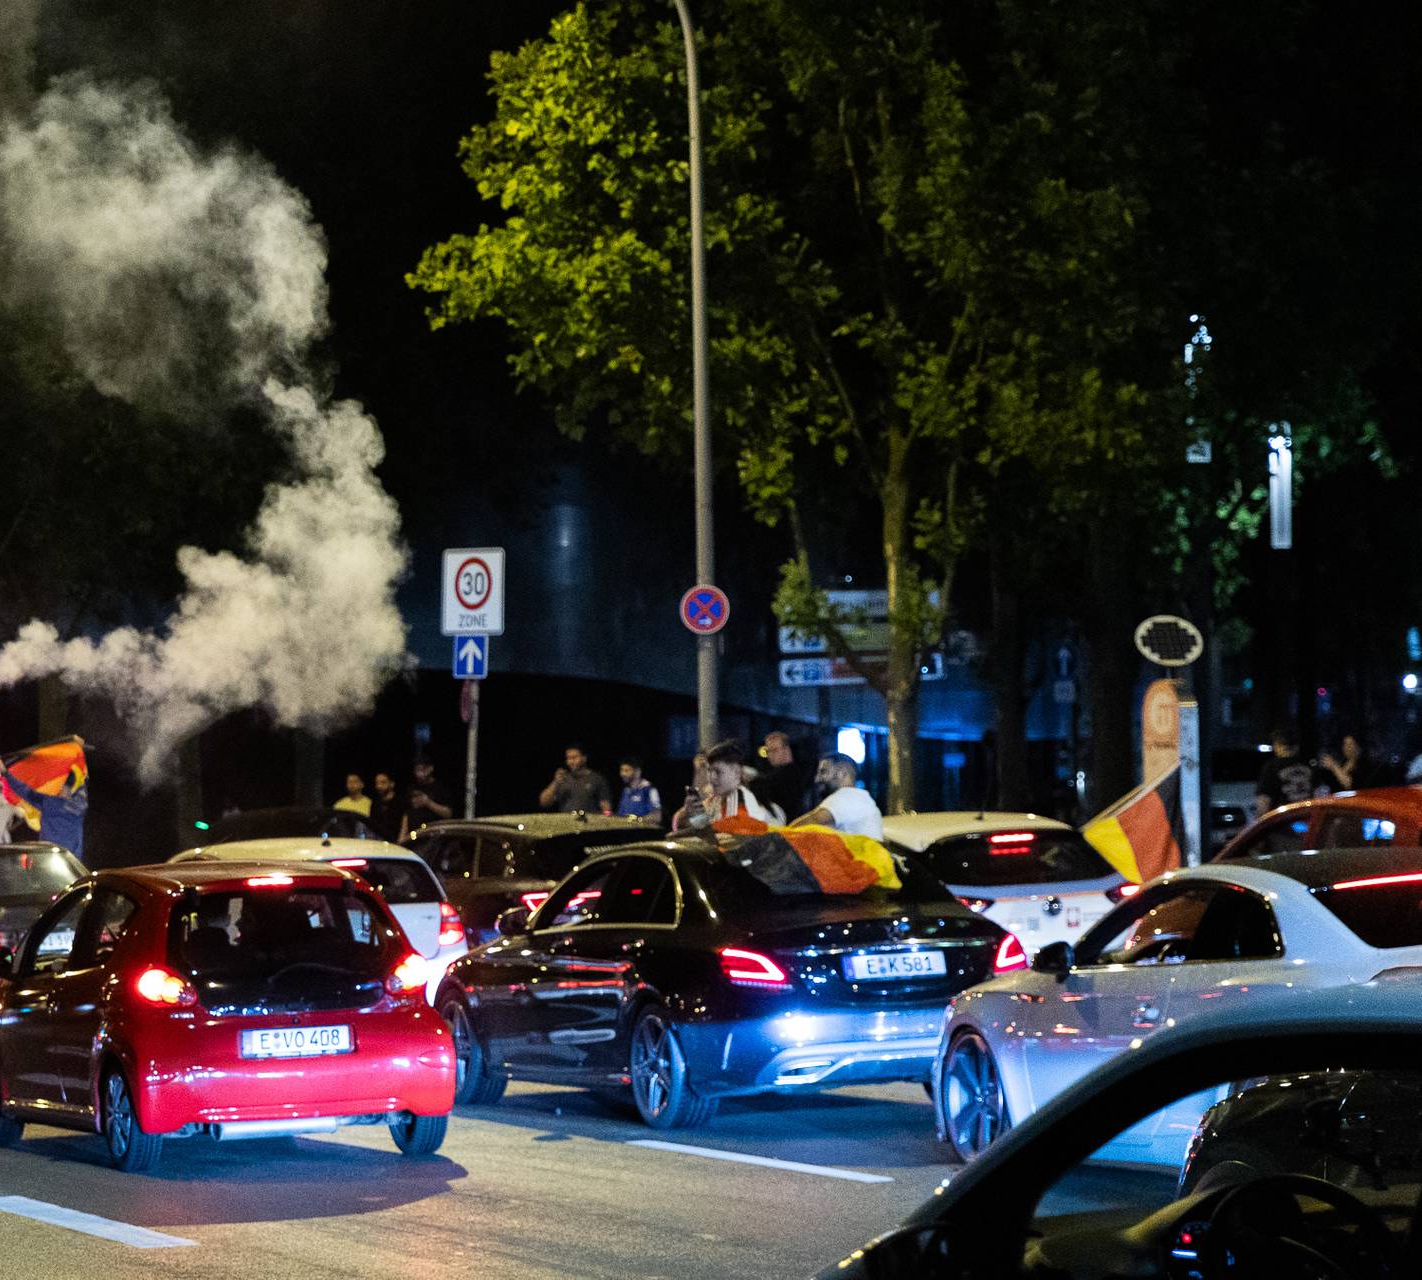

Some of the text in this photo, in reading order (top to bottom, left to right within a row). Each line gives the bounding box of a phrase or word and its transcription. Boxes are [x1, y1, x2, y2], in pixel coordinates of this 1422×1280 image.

[463, 572, 485, 596] 30
[458, 613, 488, 628] ZONE
[902, 955, 933, 973] 581
[309, 1028, 340, 1047] 408
